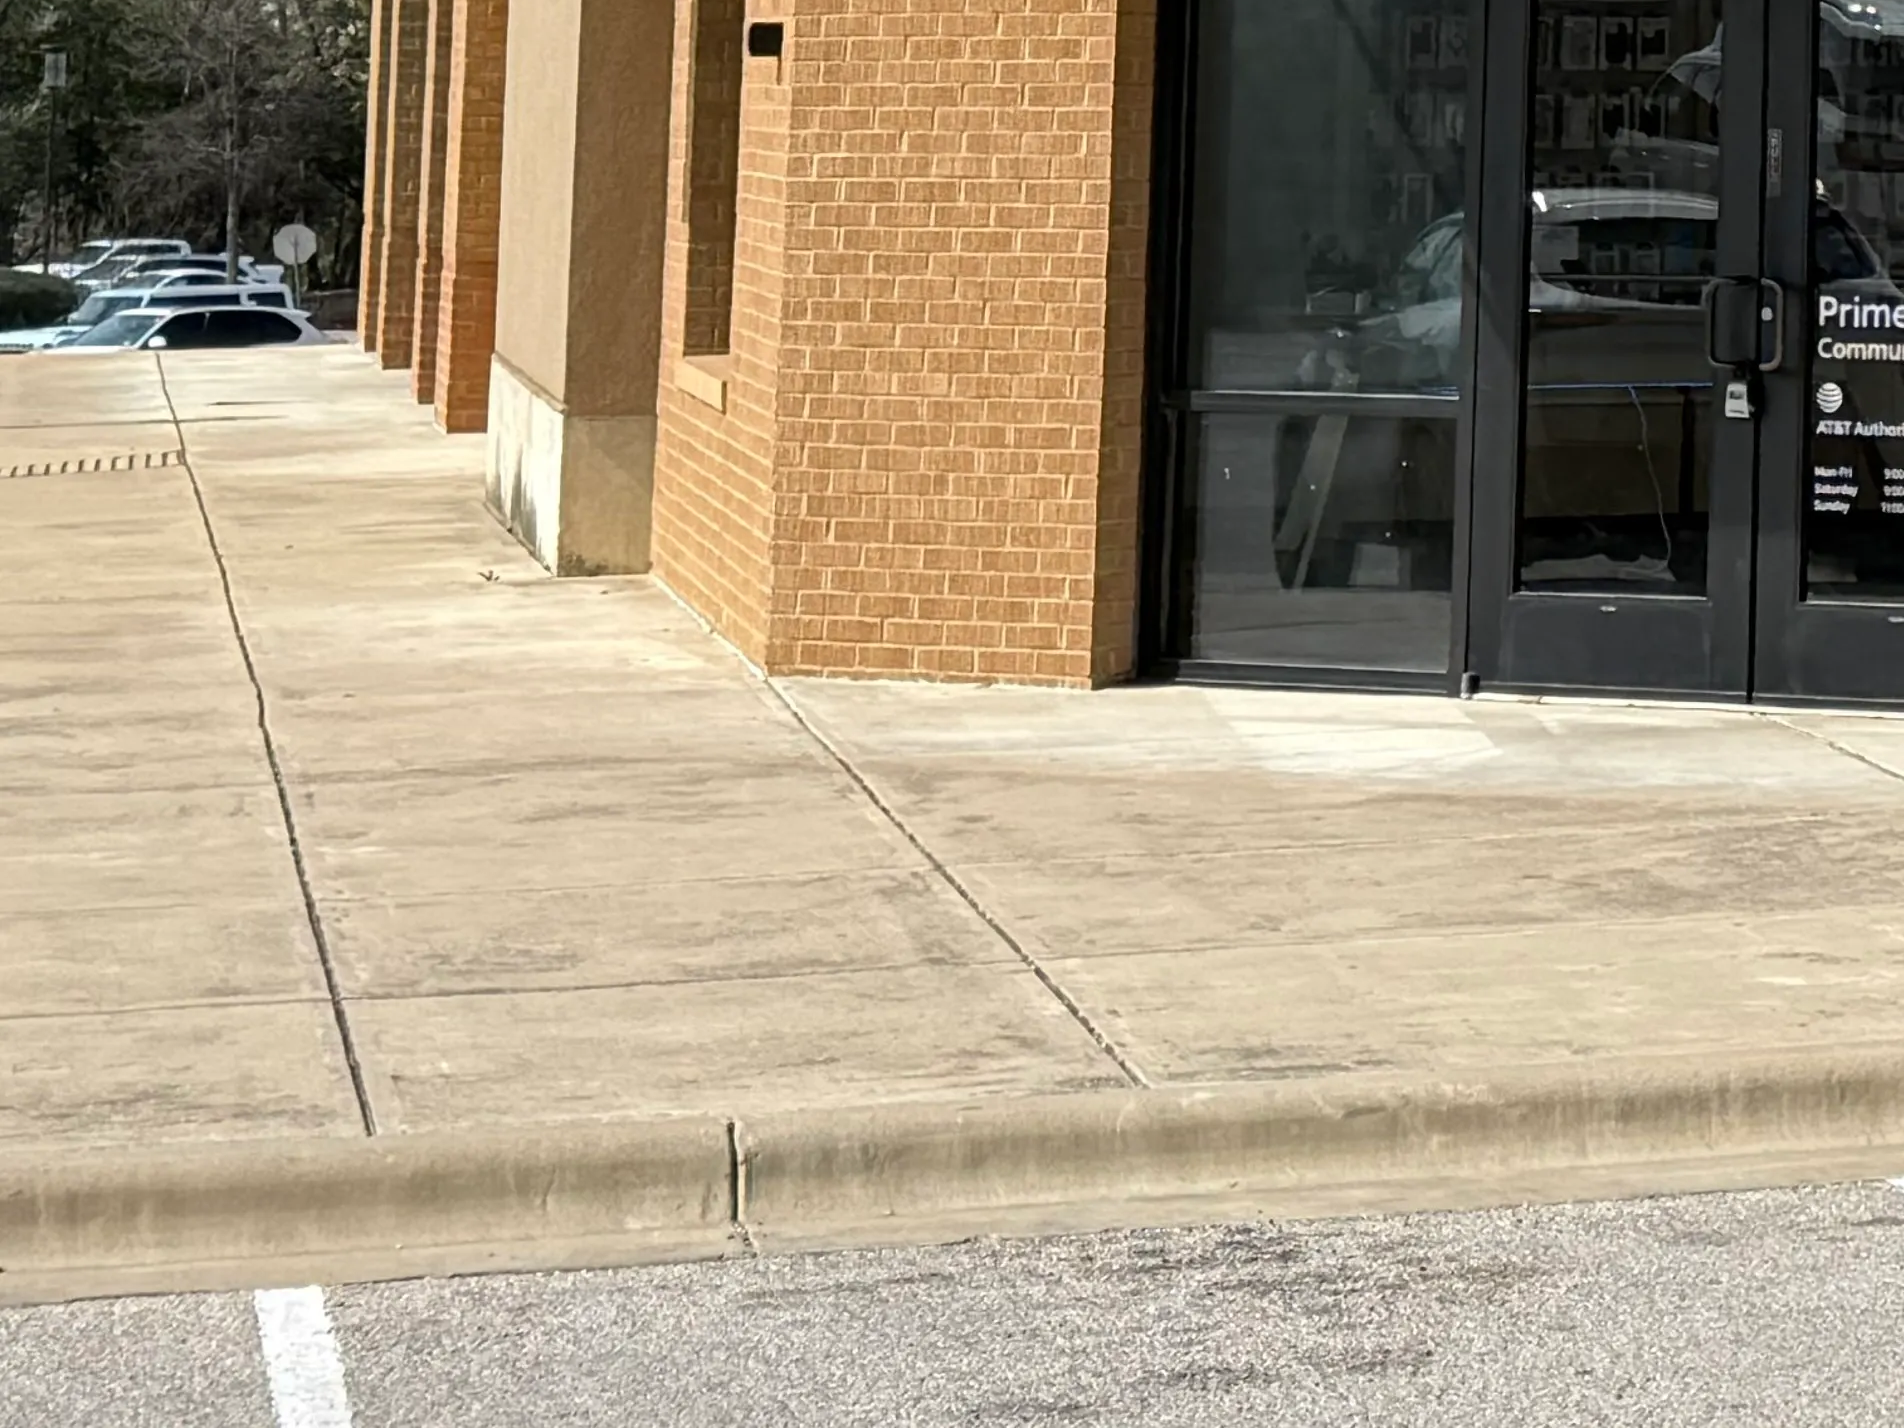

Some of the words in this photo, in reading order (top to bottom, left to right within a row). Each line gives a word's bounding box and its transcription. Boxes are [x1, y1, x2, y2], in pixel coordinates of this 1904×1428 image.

[1816, 420, 1851, 435] AT&T
[1814, 483, 1858, 497] Saturday
[1814, 499, 1850, 514] Sunday
